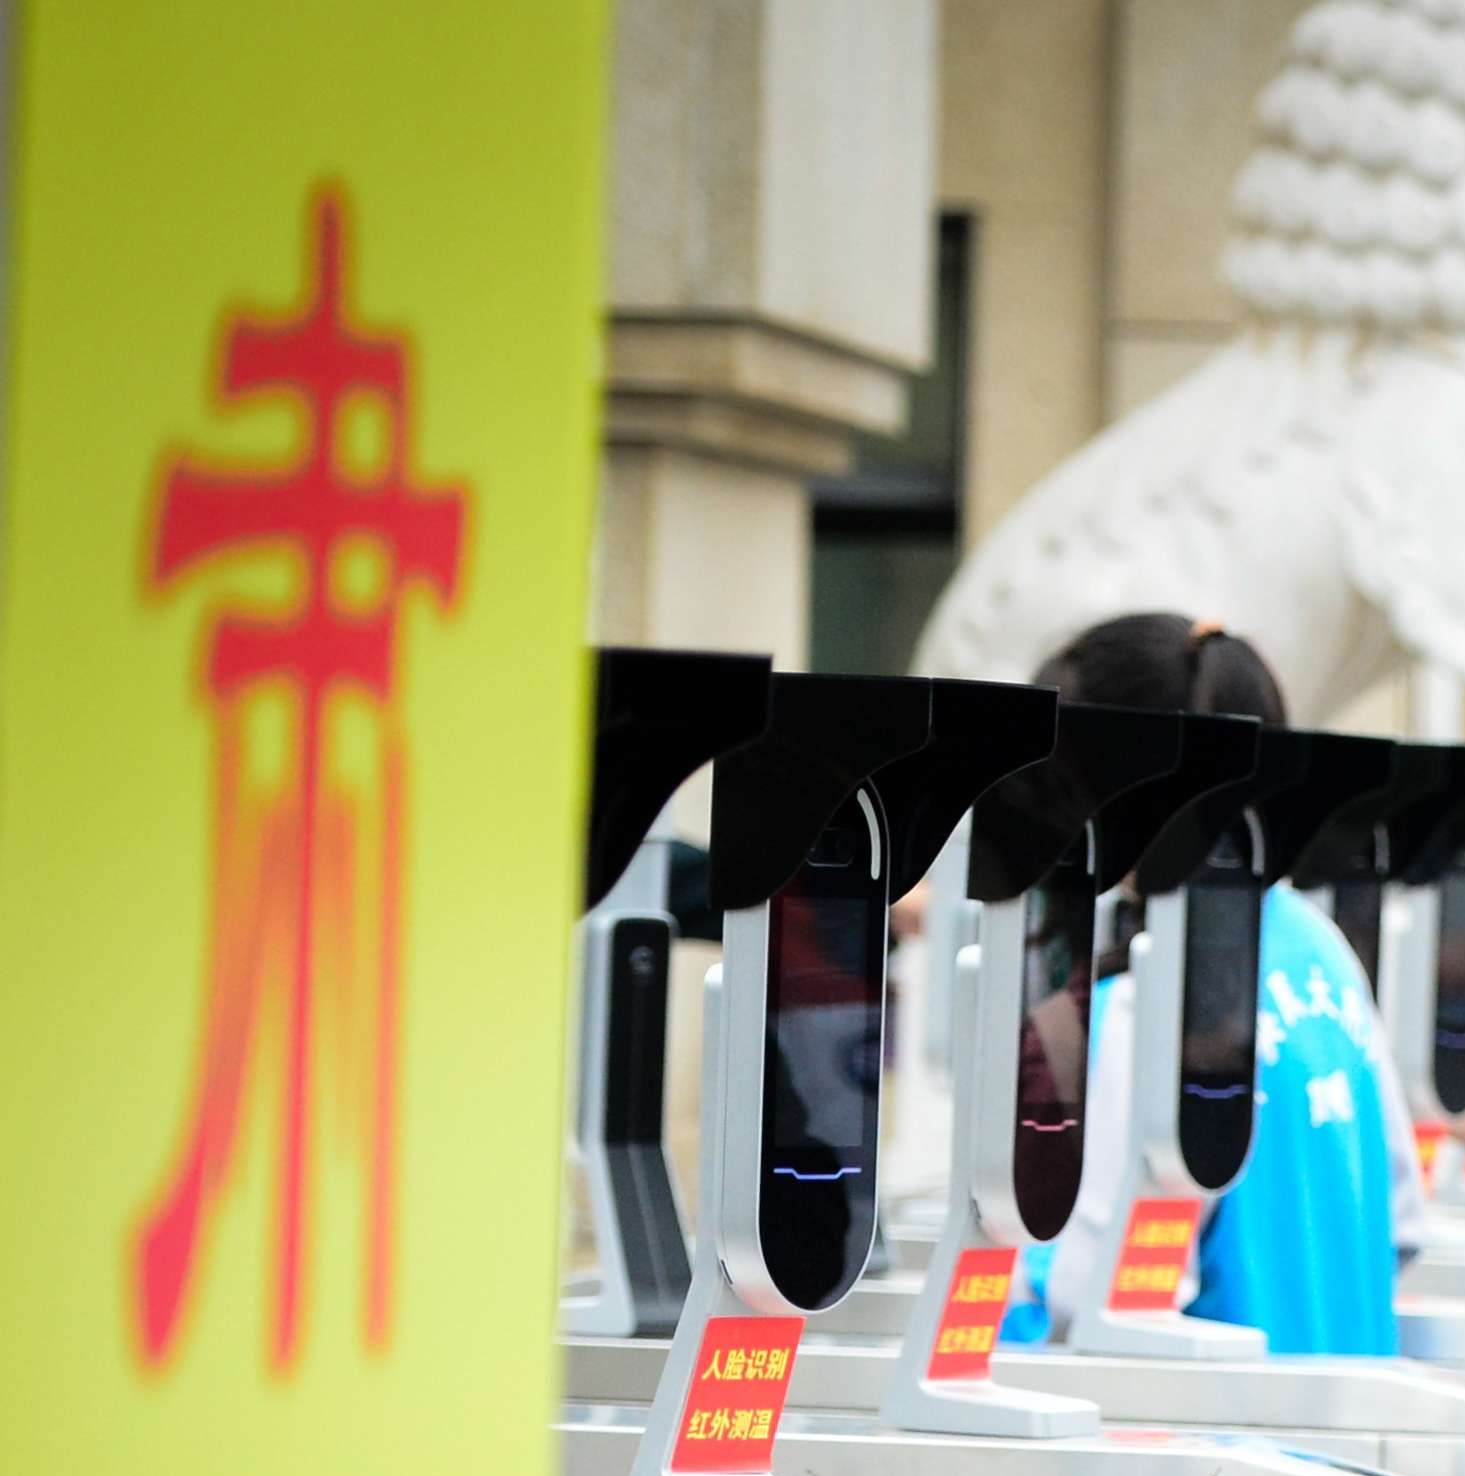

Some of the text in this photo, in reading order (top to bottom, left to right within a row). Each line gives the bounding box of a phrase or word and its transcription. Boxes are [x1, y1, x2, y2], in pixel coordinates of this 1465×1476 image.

[701, 1348, 789, 1380] 人脸识别
[686, 1408, 773, 1440] 红外测温
